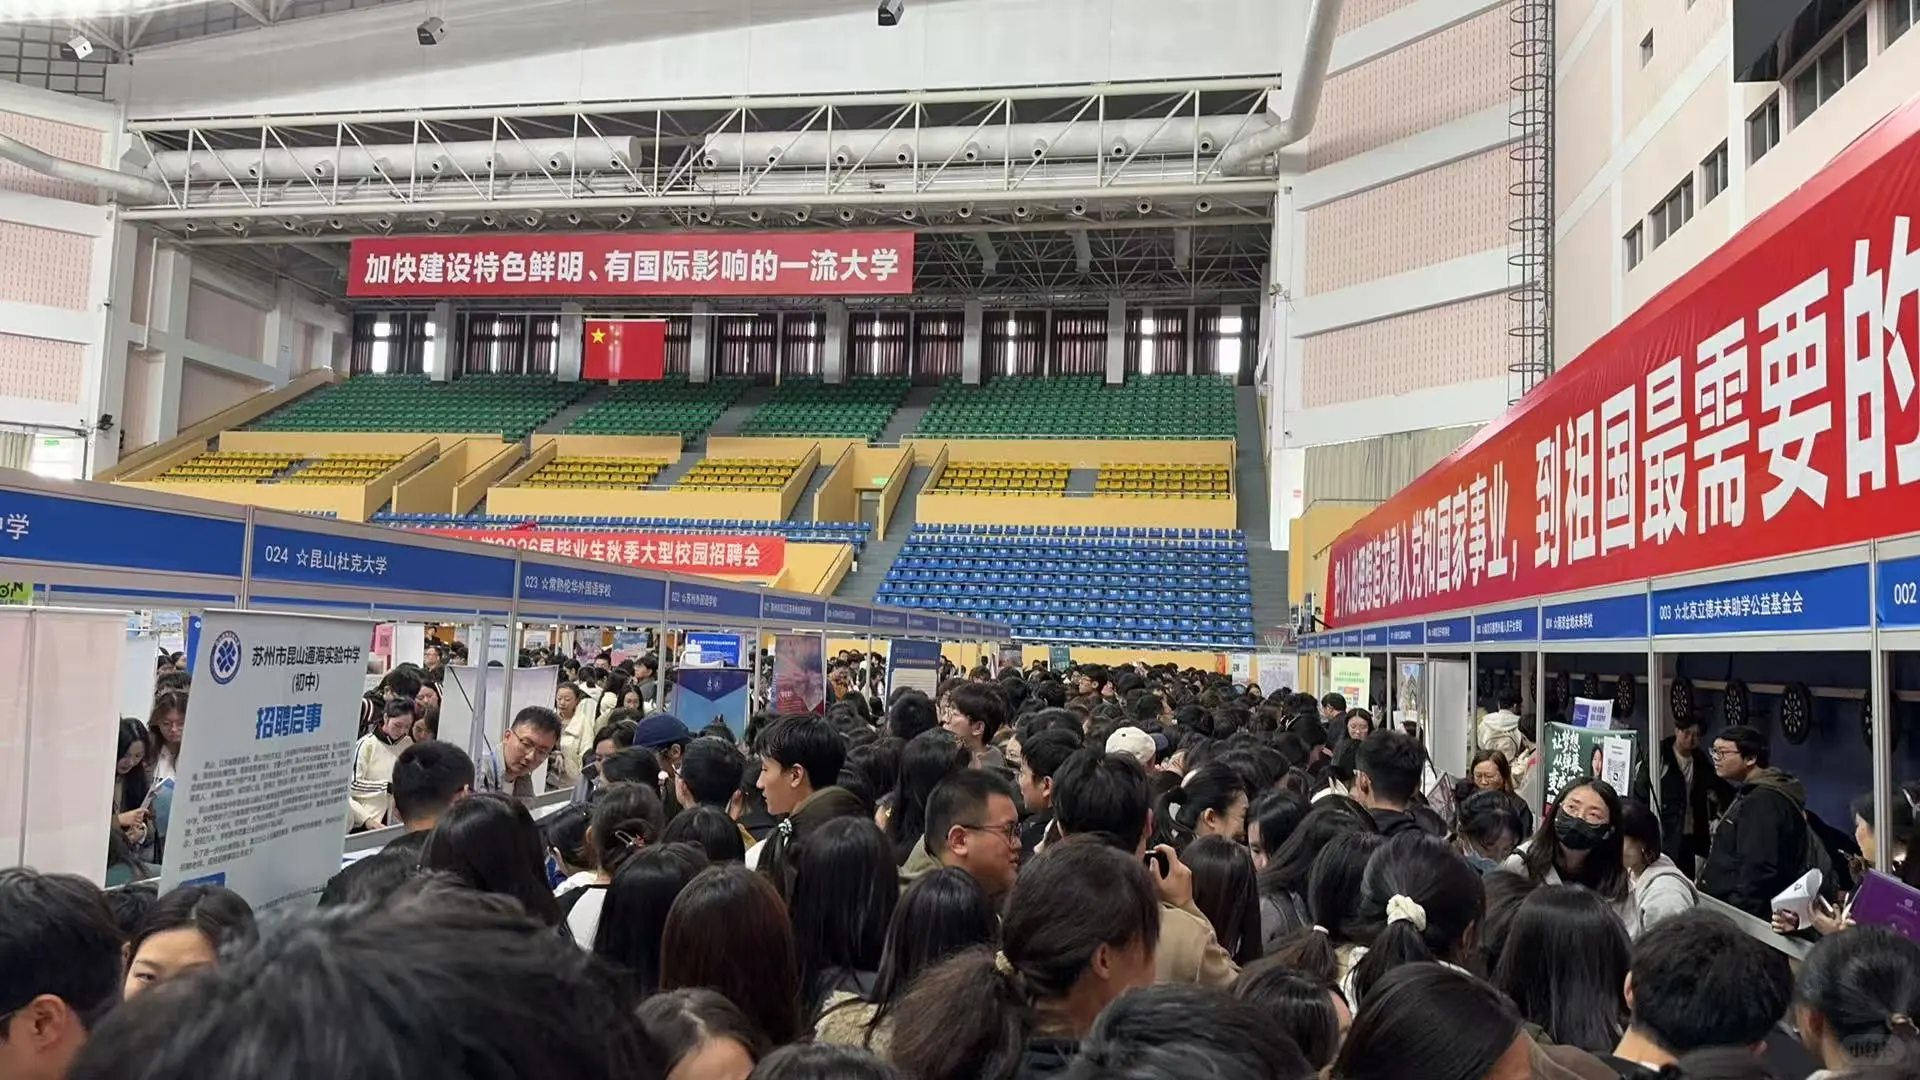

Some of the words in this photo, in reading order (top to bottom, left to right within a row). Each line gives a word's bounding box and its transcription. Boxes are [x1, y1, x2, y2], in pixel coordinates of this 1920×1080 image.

[365, 248, 899, 284] 加快建设特色鲜明、有国际影响的一流大学
[0, 513, 29, 540] 学
[265, 545, 289, 564] 024
[525, 576, 538, 589] 023
[1894, 582, 1917, 605] 002
[1660, 605, 1671, 620] 003
[1682, 590, 1804, 620] 北京立德未来助学公益基金会
[252, 645, 361, 667] 苏州市昆山通海实验中学
[255, 703, 323, 740] 招聘启事
[1552, 729, 1580, 753] 让梦想
